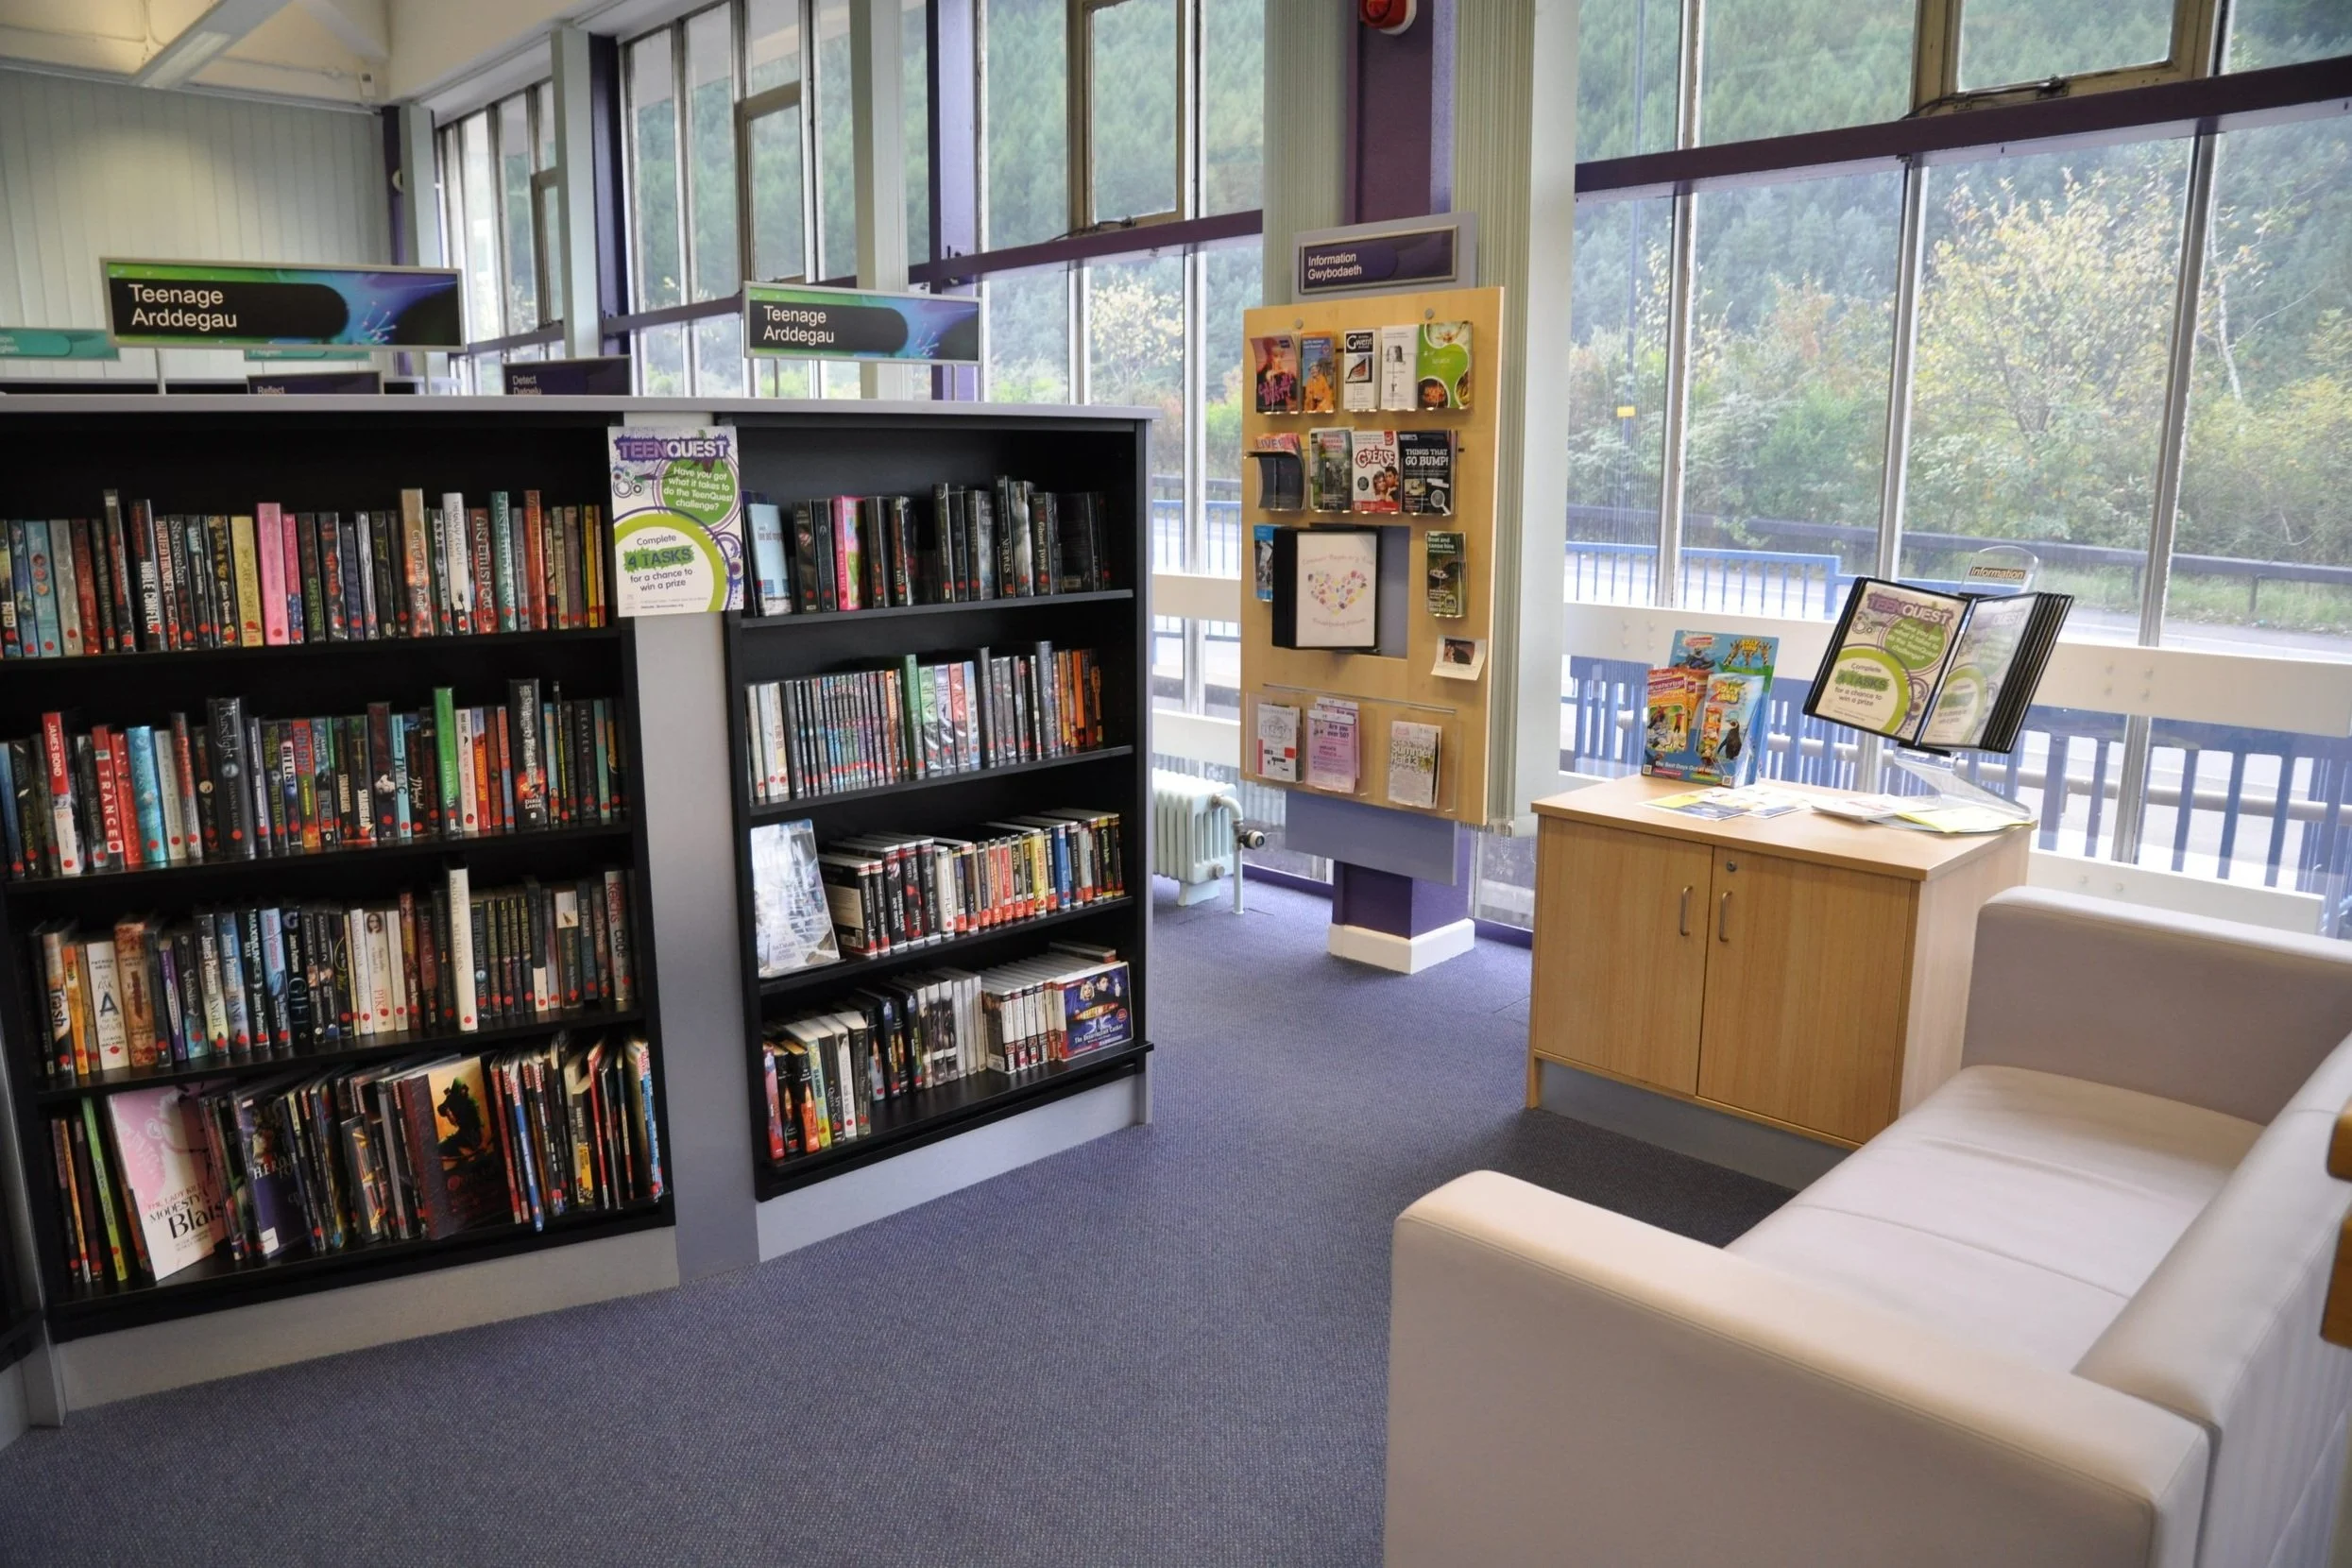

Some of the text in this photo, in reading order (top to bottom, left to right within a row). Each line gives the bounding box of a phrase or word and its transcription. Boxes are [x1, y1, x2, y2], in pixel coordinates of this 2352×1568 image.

[1308, 252, 1356, 266] Information
[1308, 264, 1362, 281] Gwybodaeth
[128, 283, 223, 307] Teenage
[131, 308, 238, 332] Arddegau
[764, 305, 827, 326] Teenage
[763, 327, 834, 347] Arddegau
[1346, 334, 1373, 350] Gwent
[512, 375, 537, 386] Detect
[620, 437, 727, 460] TEENQUEST
[1355, 445, 1396, 469] GREASE
[1406, 448, 1428, 456] THINGS
[1406, 456, 1449, 467] GO BUMP!
[668, 477, 690, 486] what
[698, 480, 721, 490] takes
[723, 483, 730, 492] to
[673, 467, 727, 484] Have you got
[663, 486, 733, 503] do the TeenQuest
[675, 500, 719, 511] challenge?
[473, 516, 491, 580] ARTEMIS
[637, 534, 677, 547] Complete
[1037, 521, 1047, 571] Ghost TOWN
[154, 520, 174, 592] BURIED THUNDER
[169, 520, 187, 586] Starseeker
[627, 548, 692, 569] 4 TASKS
[140, 561, 154, 588] NOBLE
[410, 529, 426, 611] City Fallen Ange
[630, 571, 641, 584] for
[653, 570, 683, 581] chance
[684, 568, 693, 577] to
[1970, 567, 2026, 580] Information
[640, 581, 656, 592] win
[665, 578, 687, 591] prize
[579, 708, 589, 753] HEAVEN
[47, 722, 62, 776] JAMES BOND
[312, 731, 321, 762] HOLLAND
[1391, 742, 1434, 758] Summer
[394, 756, 407, 794] TWOC
[474, 747, 486, 801] EVERYBODY JAM
[99, 769, 117, 839] TRANCE
[944, 897, 952, 916] FLIP
[221, 933, 234, 956] James
[288, 933, 297, 949] James
[291, 949, 299, 973] Patterson
[200, 935, 221, 1030] James Patterson ANGEL
[224, 957, 239, 992] Patterson
[49, 986, 67, 1028] Trash
[252, 992, 262, 1011] James
[165, 1199, 228, 1239] Blais
